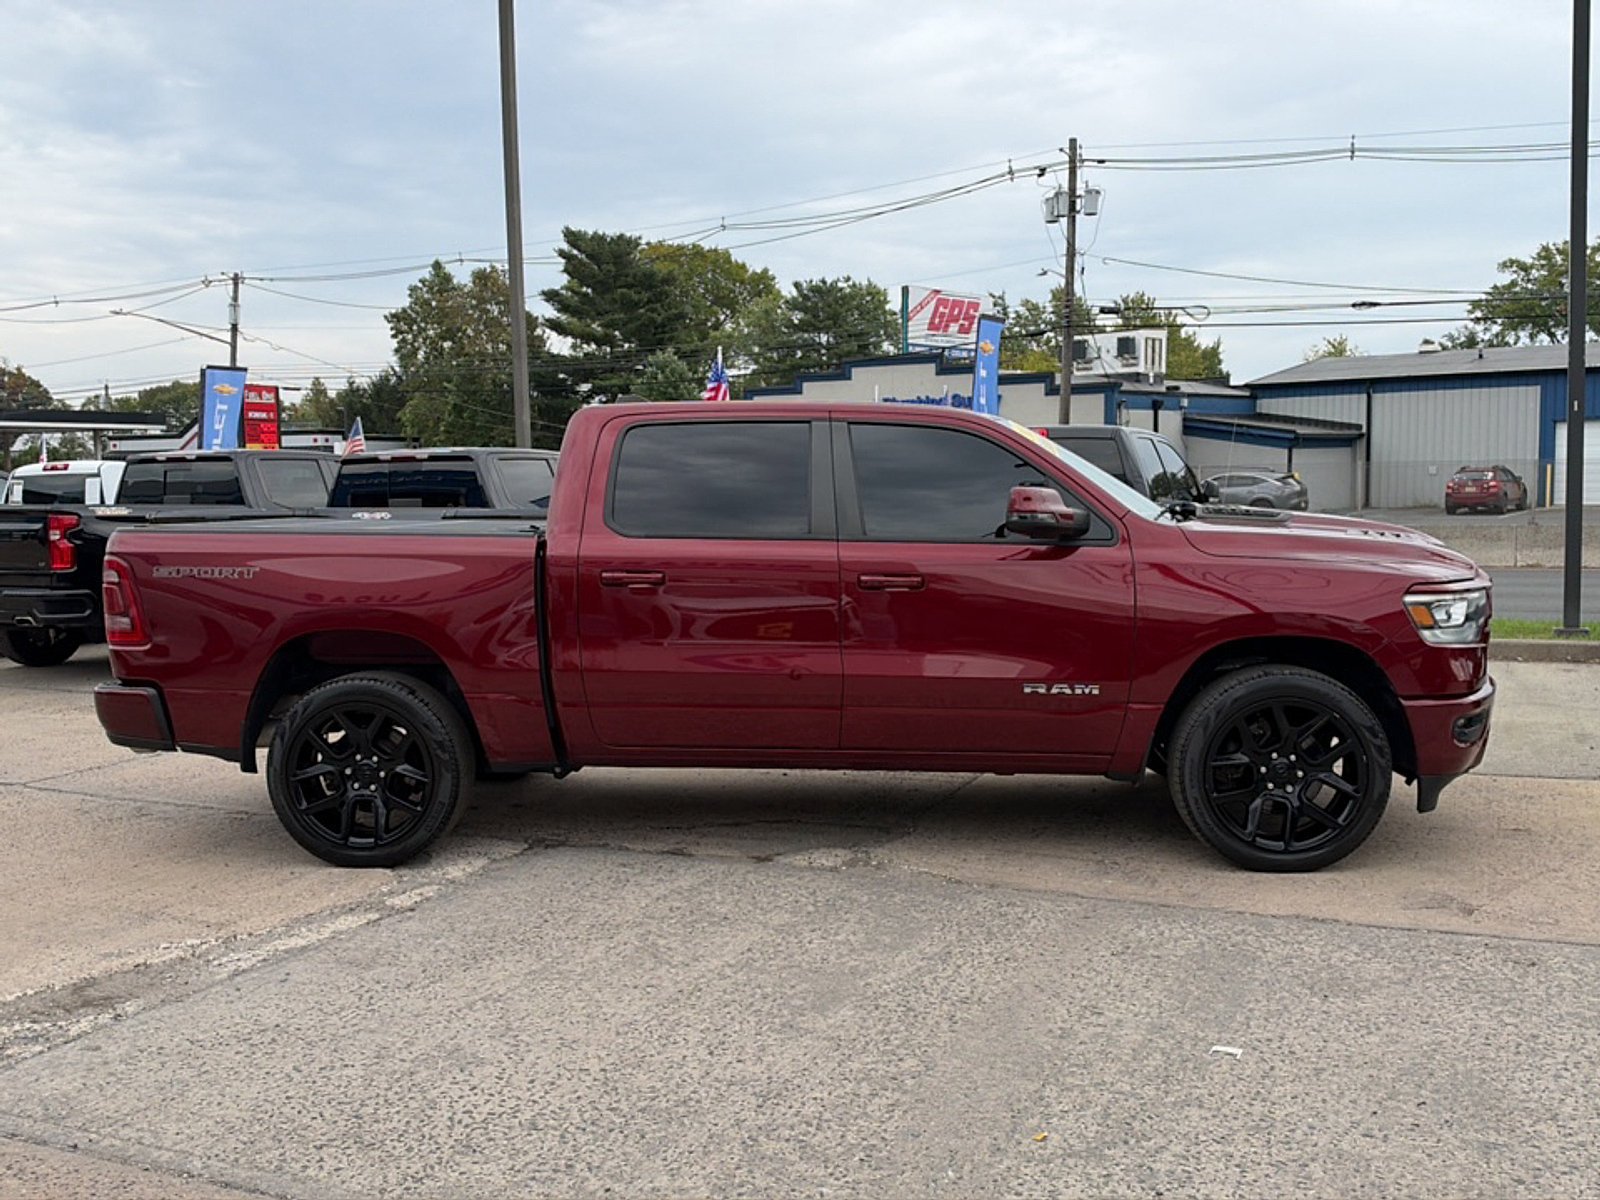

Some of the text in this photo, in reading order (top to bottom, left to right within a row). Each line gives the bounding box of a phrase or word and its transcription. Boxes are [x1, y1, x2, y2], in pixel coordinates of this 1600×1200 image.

[927, 297, 980, 335] GPS
[152, 565, 260, 579] SPORT
[1023, 683, 1100, 695] RAM
